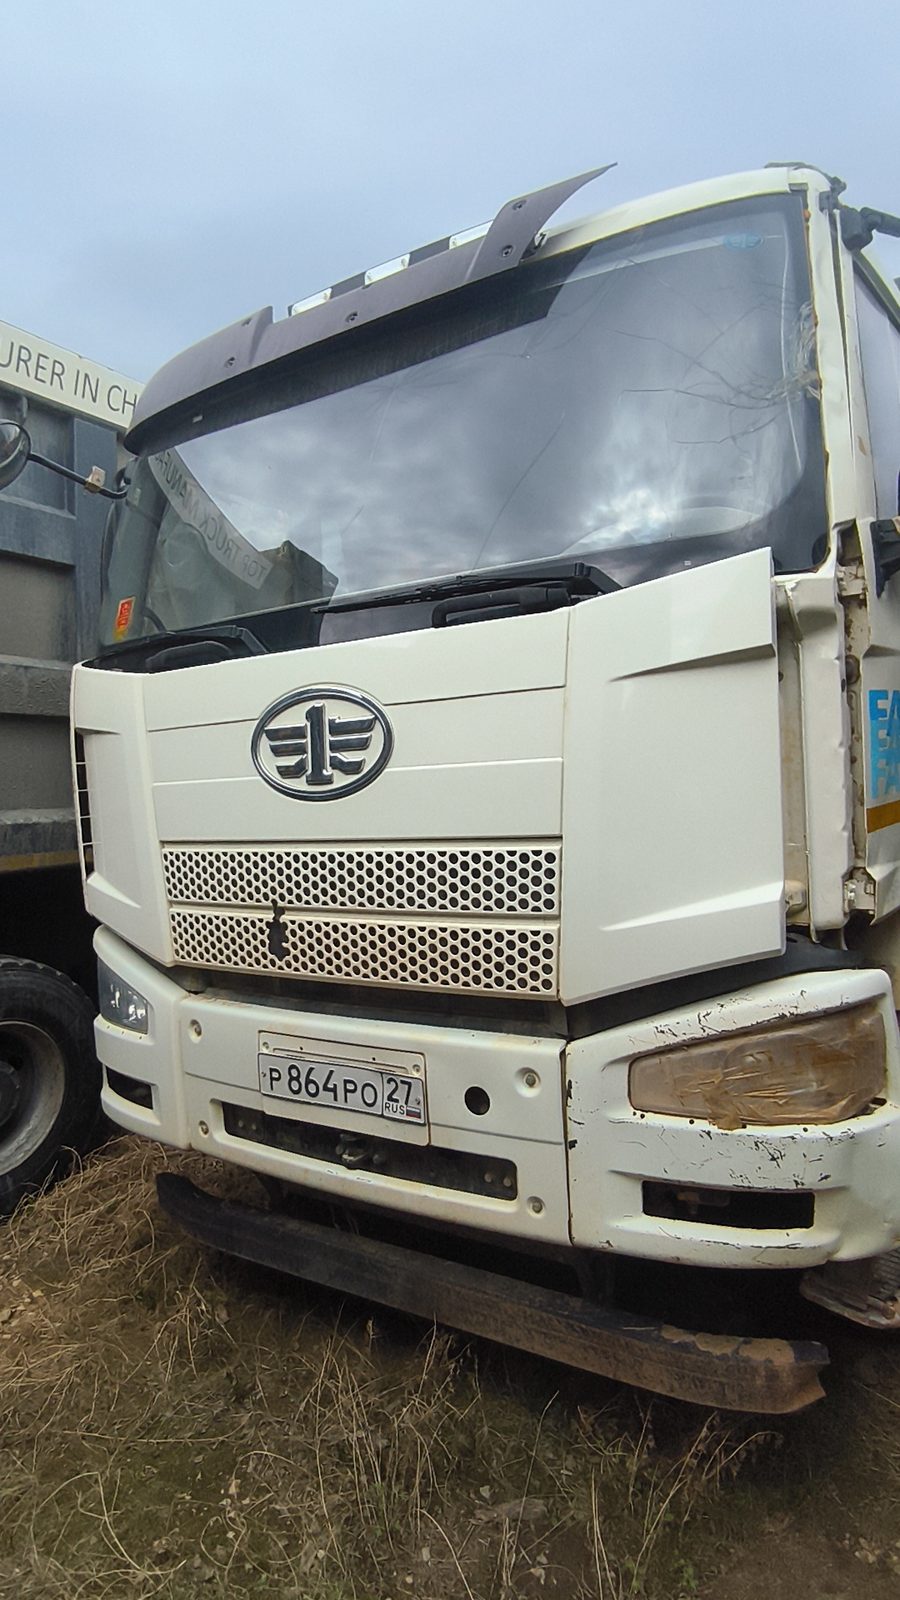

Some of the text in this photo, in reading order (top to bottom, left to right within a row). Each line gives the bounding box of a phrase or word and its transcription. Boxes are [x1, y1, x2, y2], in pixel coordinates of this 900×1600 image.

[74, 370, 100, 403] IN
[386, 1077, 413, 1105] 27
[384, 1102, 405, 1115] RUS
